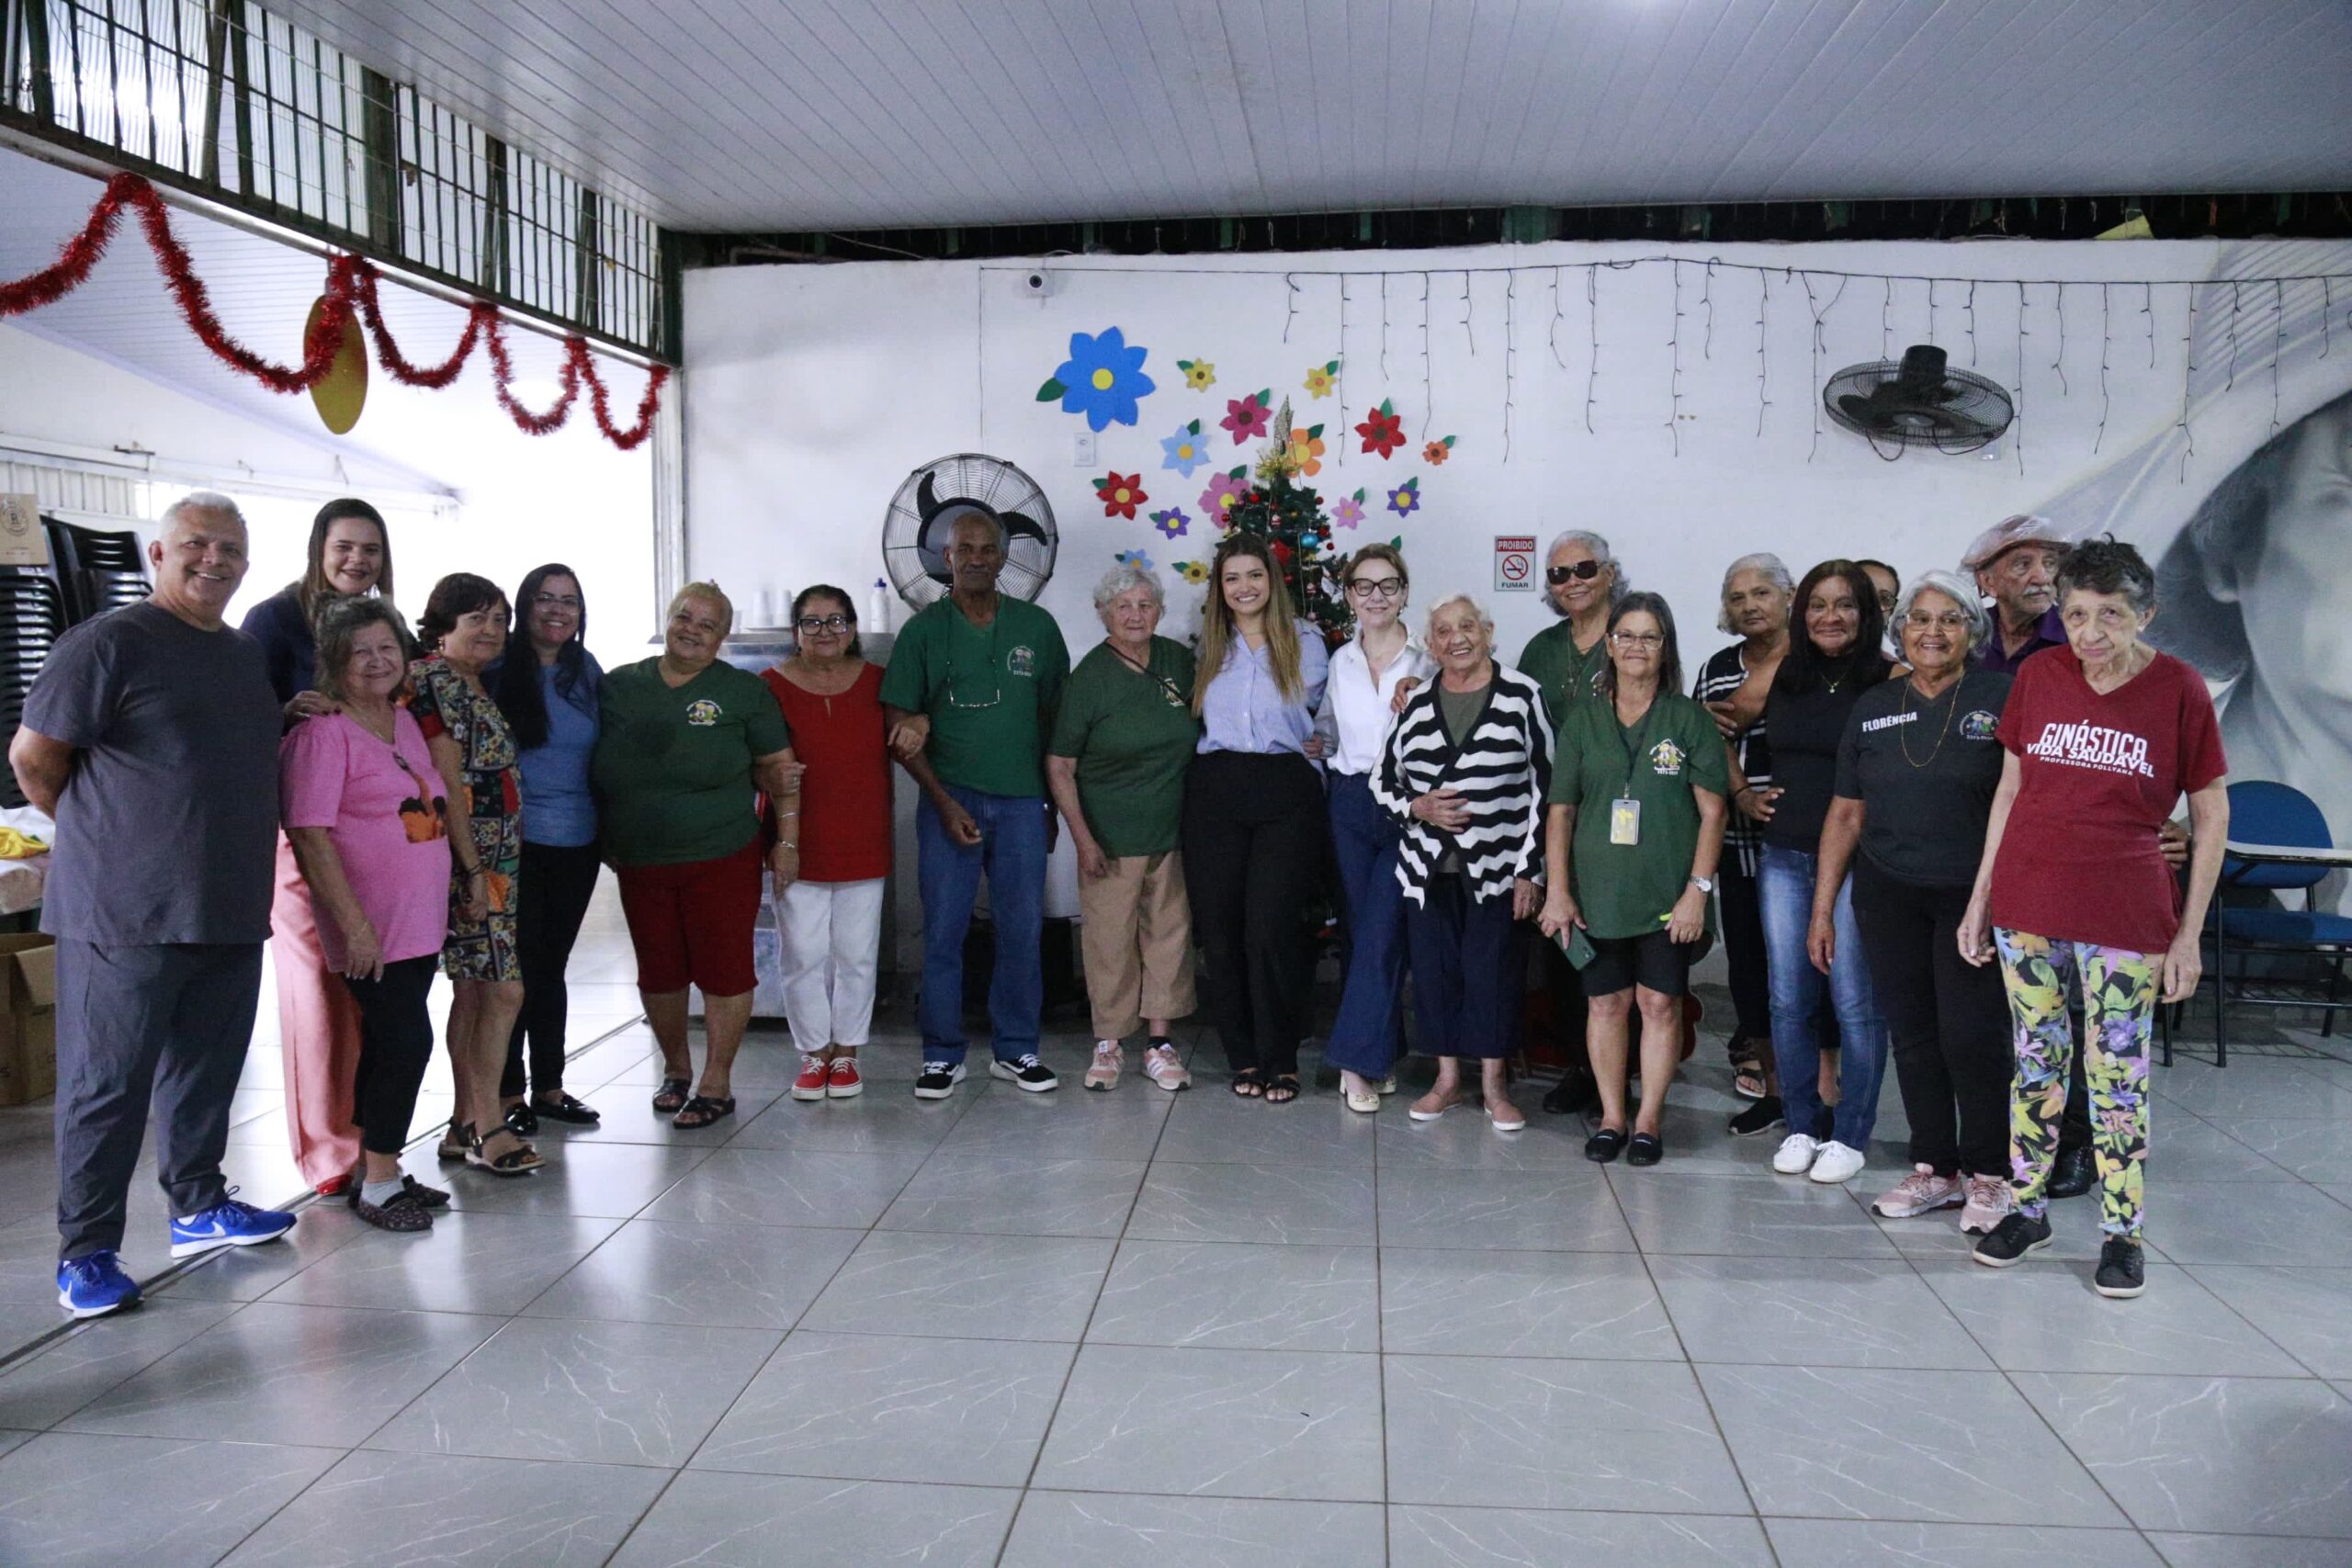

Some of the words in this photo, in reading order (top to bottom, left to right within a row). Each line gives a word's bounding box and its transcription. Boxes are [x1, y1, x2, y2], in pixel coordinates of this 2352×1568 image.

[1498, 540, 1532, 550] PROIBIDO
[2039, 719, 2147, 761] GINÁSTICA
[2027, 743, 2063, 758] VIDA
[2068, 747, 2154, 778] SAUDÁVEL
[2040, 756, 2091, 769] PROFESSORA
[2093, 763, 2133, 776] POLLYANA
